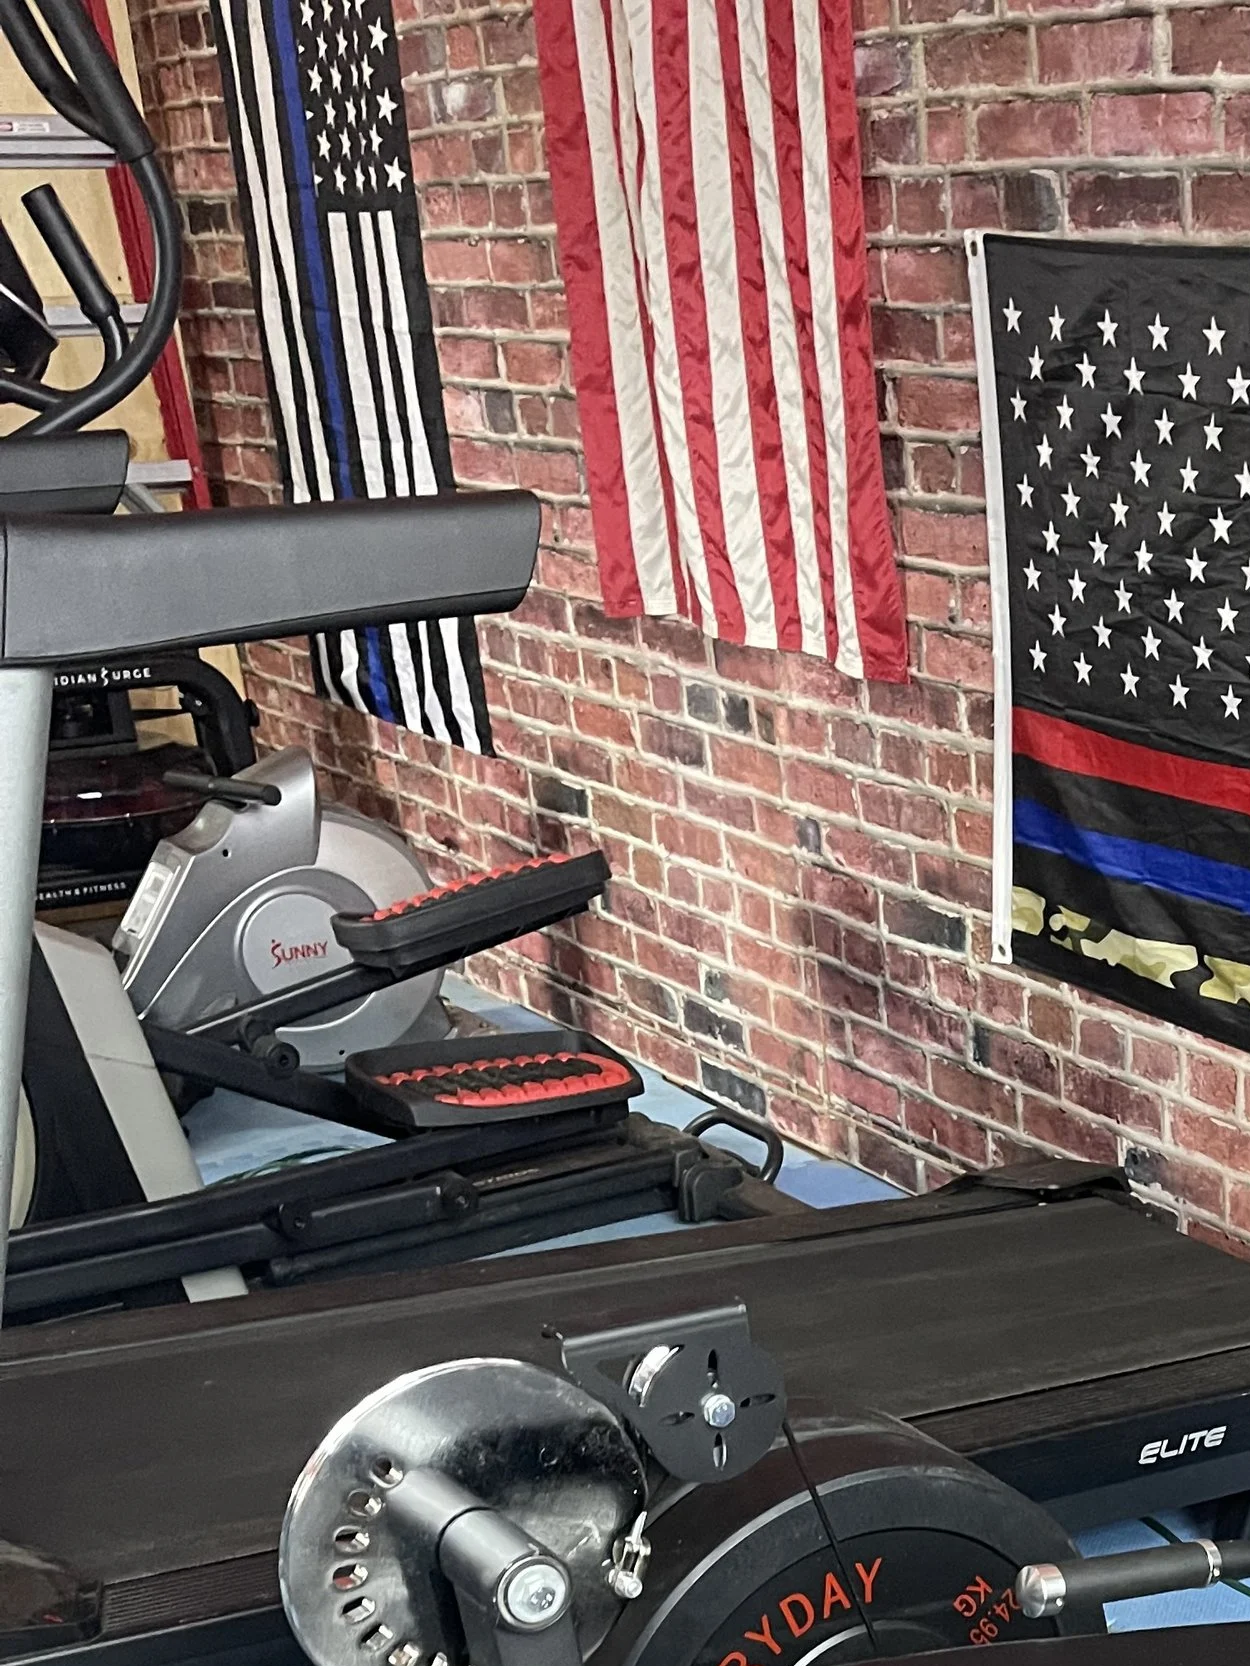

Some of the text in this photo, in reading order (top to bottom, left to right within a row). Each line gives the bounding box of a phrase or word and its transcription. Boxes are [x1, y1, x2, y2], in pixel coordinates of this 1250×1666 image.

[100, 666, 151, 687] SURGE
[270, 938, 328, 970] SUNNY
[1138, 1425, 1227, 1465] ELITE
[953, 1575, 993, 1617] KG
